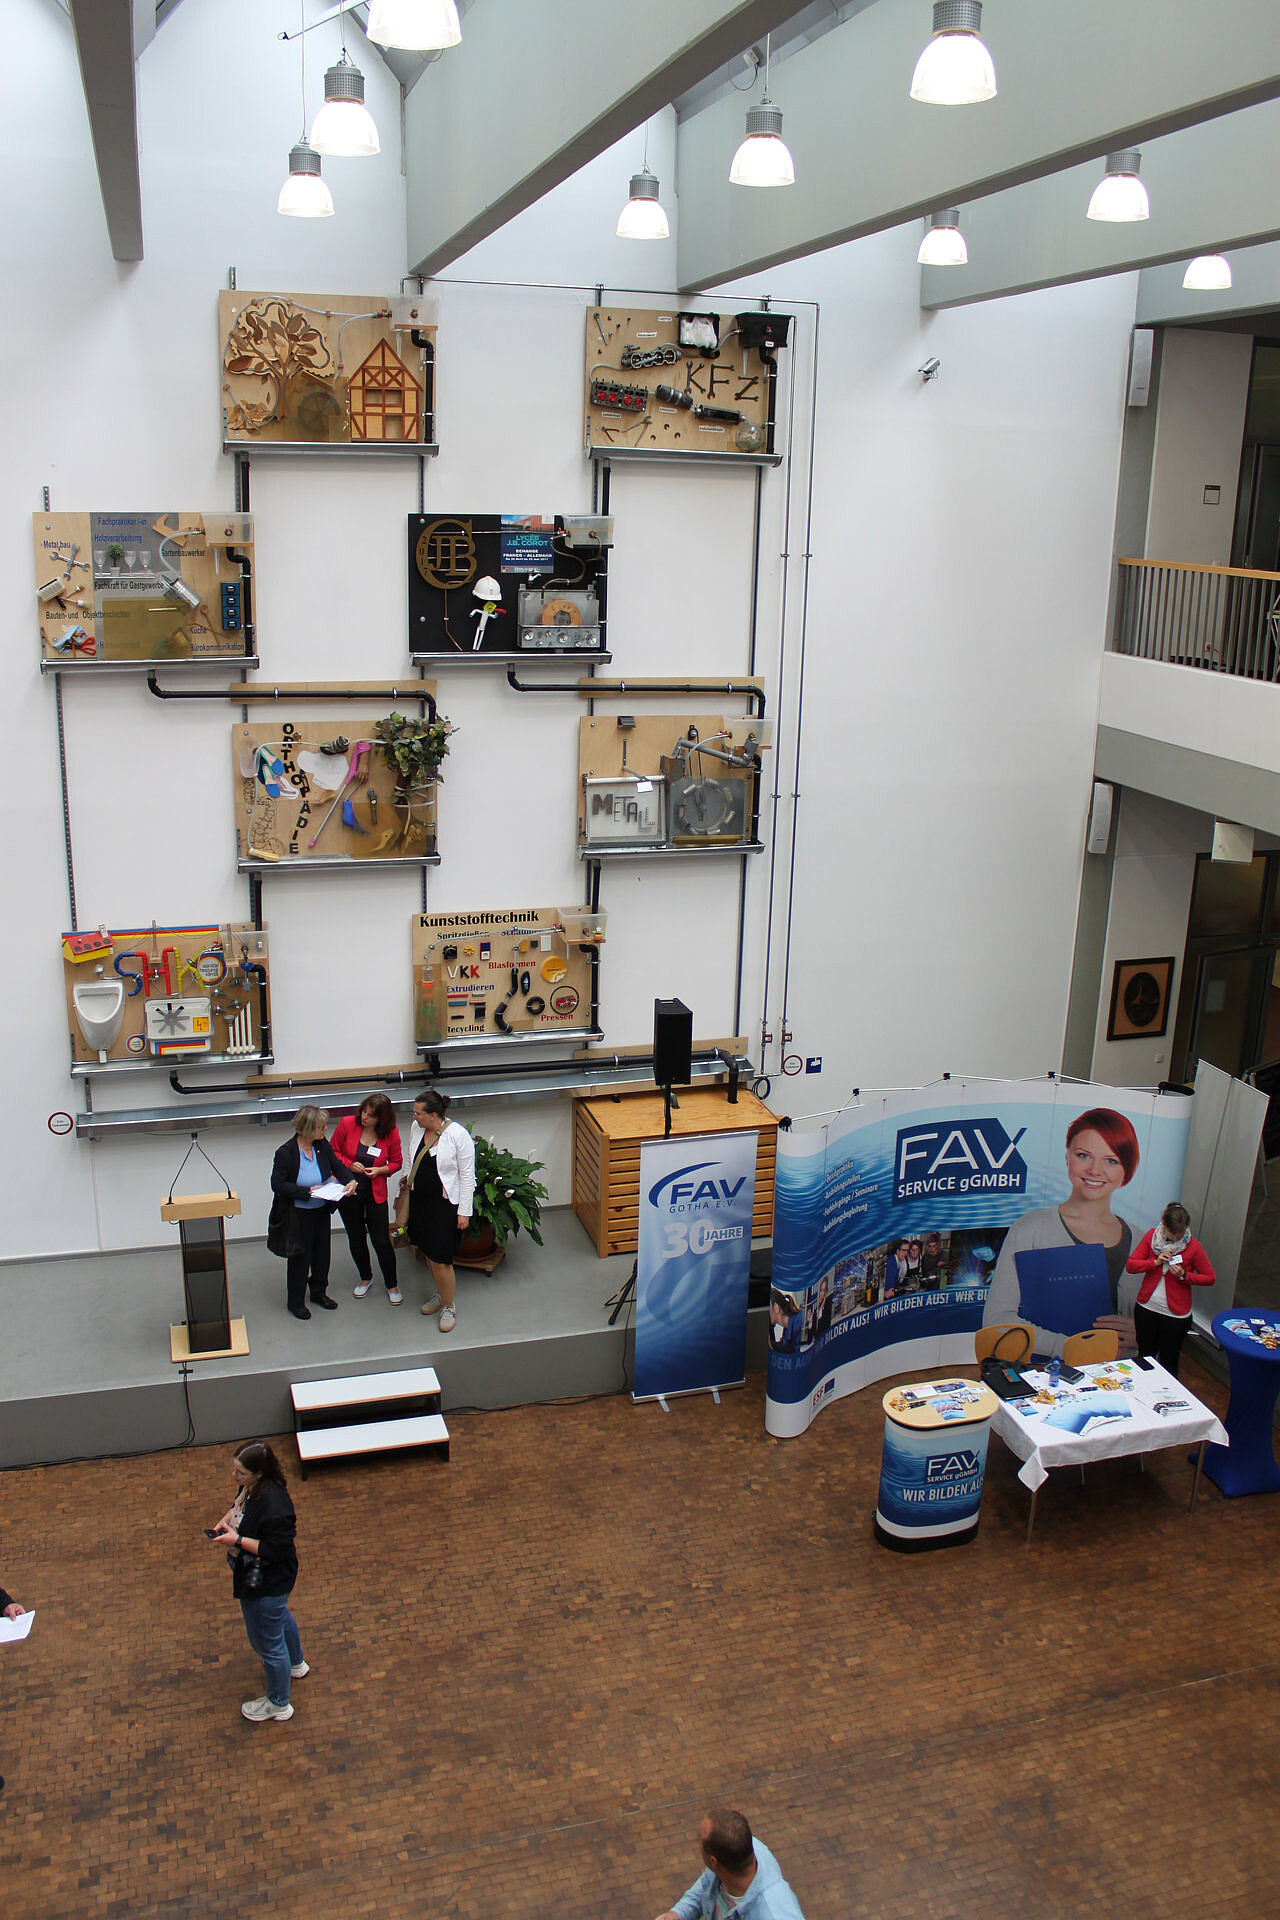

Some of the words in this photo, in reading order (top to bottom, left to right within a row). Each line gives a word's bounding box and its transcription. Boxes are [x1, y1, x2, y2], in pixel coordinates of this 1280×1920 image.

[684, 361, 759, 401] KFZ
[95, 581, 119, 590] Fachkraft
[68, 611, 79, 619] und
[419, 910, 540, 928] Kunststofftechnik
[447, 964, 480, 979] VKK
[488, 960, 537, 970] Blasformen
[446, 983, 495, 993] Extrudieren
[540, 1013, 574, 1022] Pressen
[900, 1128, 1028, 1180] FAV
[670, 1176, 748, 1205] FAV
[898, 1176, 956, 1198] SERVICE
[960, 1173, 1021, 1192] gGMBH
[669, 1201, 710, 1214] GOTHA
[716, 1199, 737, 1210] E.V.
[662, 1218, 715, 1260] 30
[705, 1227, 742, 1241] JAHRE
[825, 1321, 849, 1345] BILDEN
[850, 1312, 870, 1330] AUS!
[874, 1302, 889, 1321] WIR
[890, 1295, 923, 1314] BILDEN
[926, 1292, 949, 1306] AUS!
[955, 1289, 974, 1303] WIR
[927, 1450, 981, 1476] FAV
[927, 1473, 954, 1483] SERVICE
[903, 1488, 926, 1502] WIR
[928, 1482, 968, 1501] BILDEN
